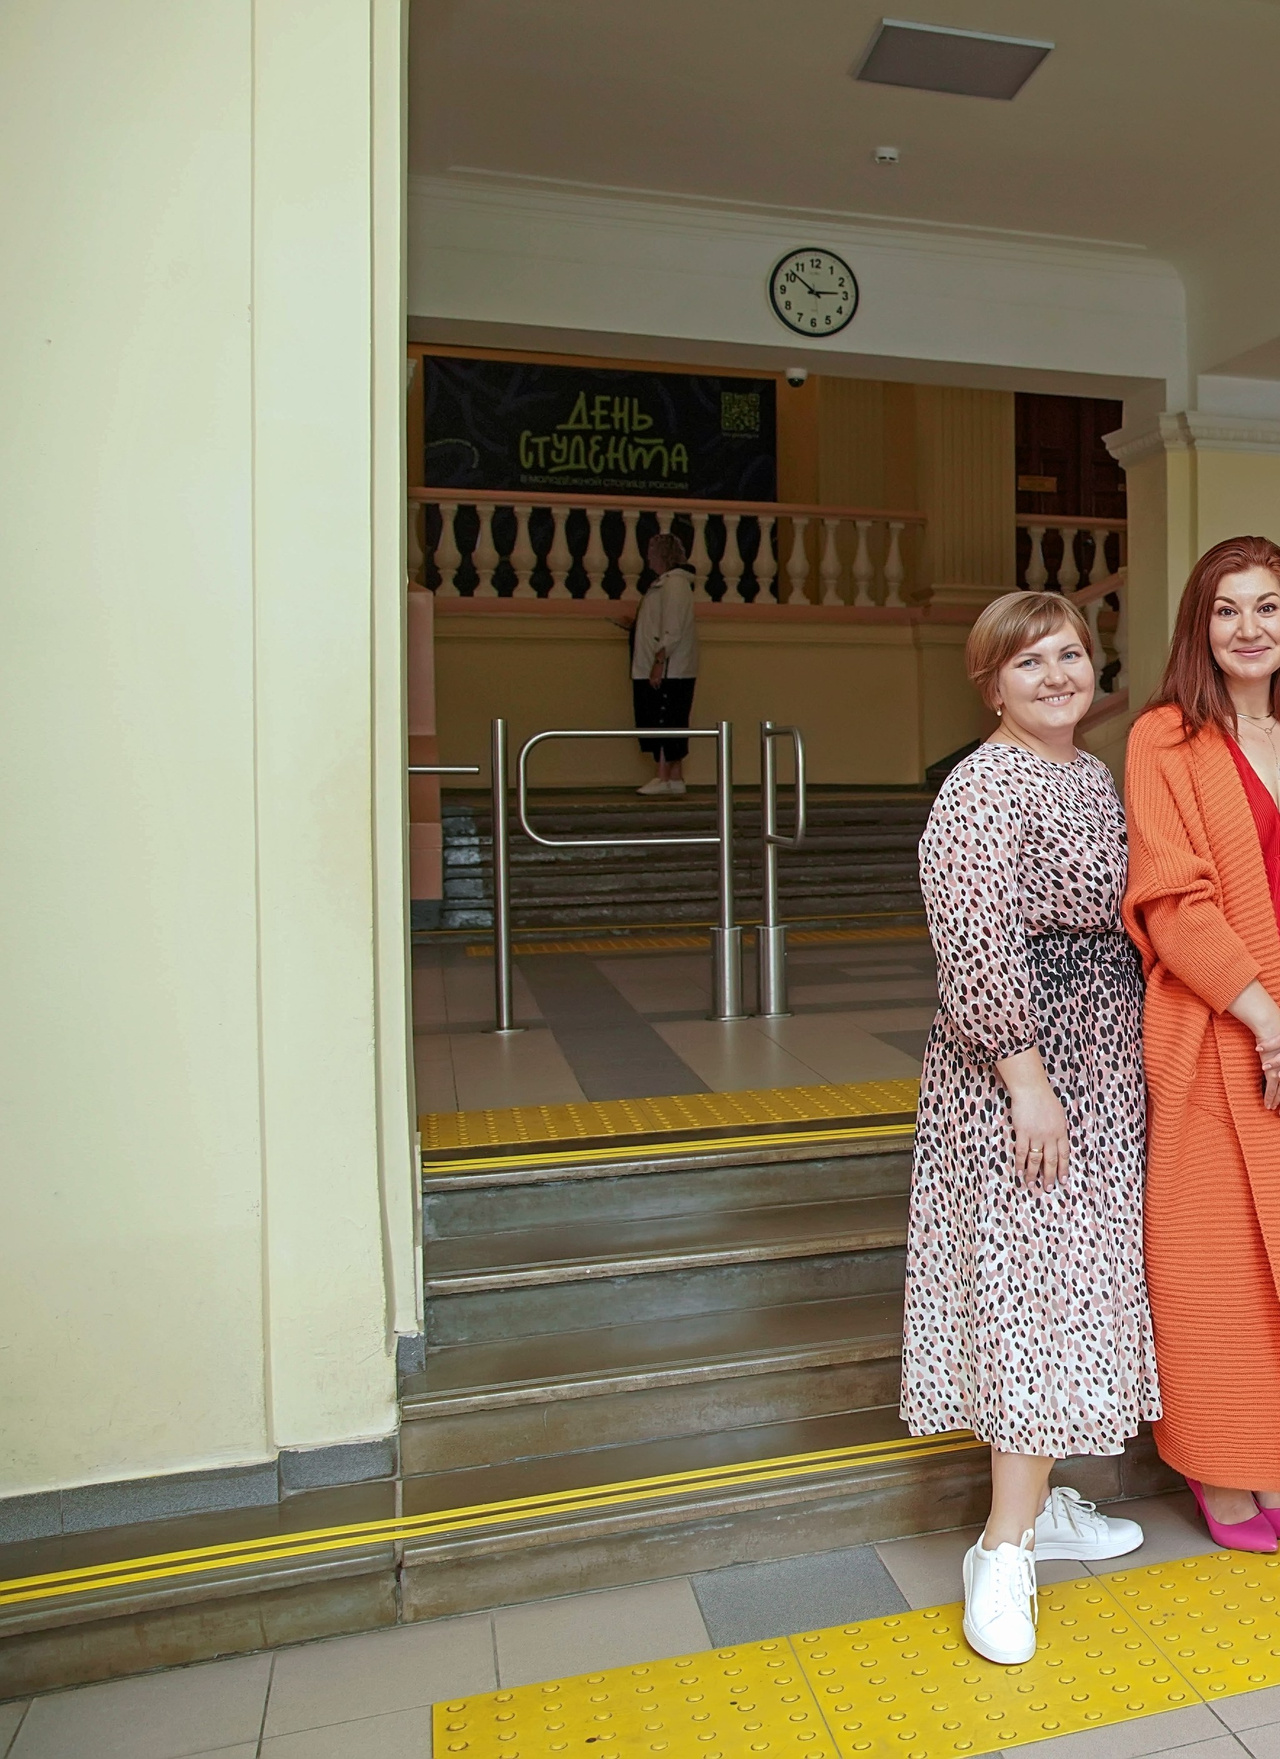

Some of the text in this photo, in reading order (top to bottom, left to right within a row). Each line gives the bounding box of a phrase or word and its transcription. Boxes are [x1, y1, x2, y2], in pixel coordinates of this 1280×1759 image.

[796, 263, 804, 272] 11
[810, 259, 821, 268] 12
[829, 266, 833, 275] 1
[785, 273, 796, 282] 10
[838, 278, 844, 287] 2
[780, 285, 786, 294] 9
[842, 291, 848, 300] 3
[785, 301, 791, 310] 8
[836, 306, 842, 314] 4
[797, 312, 803, 322] 7
[825, 316, 831, 325] 5
[810, 318, 816, 327] 6
[556, 391, 654, 434] ДЕНЬ
